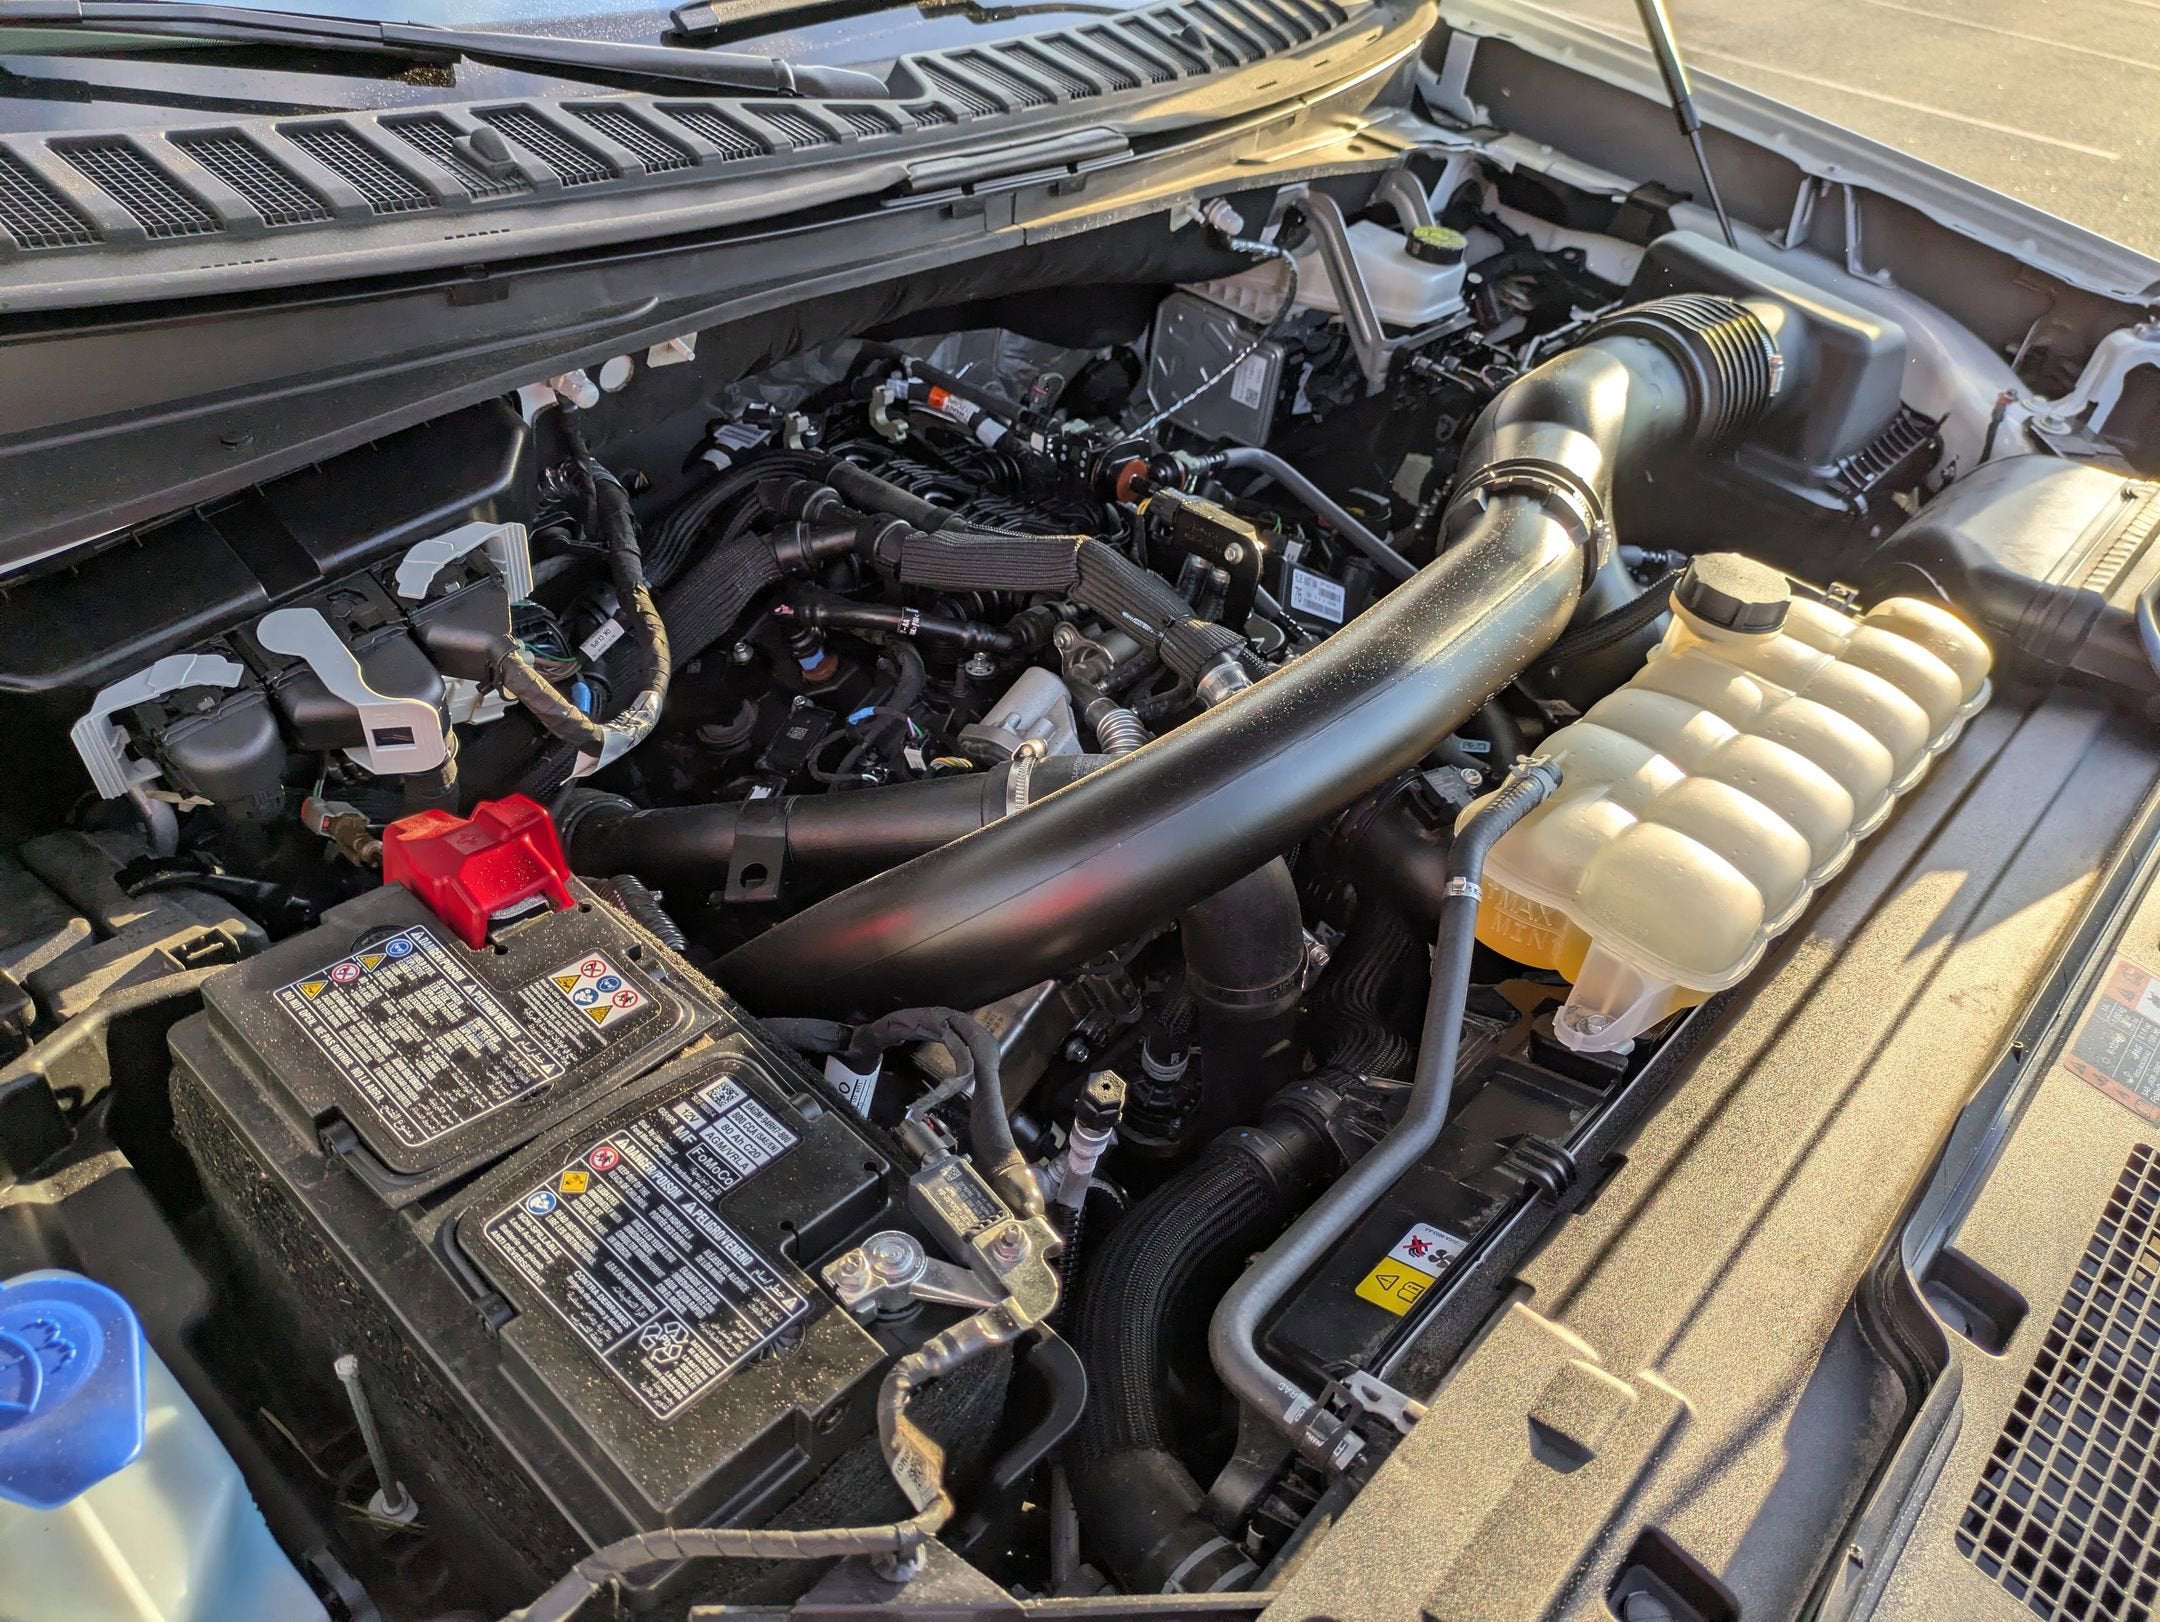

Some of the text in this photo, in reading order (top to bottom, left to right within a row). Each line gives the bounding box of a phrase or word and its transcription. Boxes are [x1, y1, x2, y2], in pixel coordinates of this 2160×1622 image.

[416, 936, 467, 982] DANGER/POISON
[469, 990, 522, 1038] PELIGRO/VENENO
[280, 990, 295, 1001] DO
[288, 998, 305, 1011] NOT
[312, 1026, 327, 1036] NE
[319, 1033, 336, 1046] PAS
[349, 1066, 364, 1078] NO
[357, 1075, 372, 1086] LA
[680, 1108, 699, 1123] 12V
[730, 1111, 747, 1124] 800
[742, 1121, 759, 1135] CCA
[742, 1102, 792, 1143] BAGM-94RH7-800
[639, 1133, 655, 1146] Motor
[670, 1124, 698, 1146] MF
[719, 1123, 762, 1159] 80 Ah C20
[704, 1131, 749, 1171] AGM/VRLA
[690, 1146, 736, 1187] FoMoCo
[638, 1186, 651, 1197] THE
[553, 1208, 569, 1223] READ
[622, 1144, 755, 1266] DANGER/POISON PELIGRO/VENENO
[516, 1211, 562, 1257] NON-SPILLABLE
[544, 1214, 560, 1228] LIRE
[554, 1224, 567, 1235] LES
[498, 1223, 545, 1271] Batterie au plomb
[508, 1216, 556, 1265] Lead Acid Battery
[489, 1229, 547, 1286] ANTI DÉVERSEMENT
[603, 1260, 617, 1272] LEA
[611, 1268, 626, 1280] LAS
[573, 1269, 600, 1296] CONTRA
[595, 1293, 632, 1328] DERRAMES
[582, 1292, 592, 1301] de
[587, 1298, 607, 1317] plomo
[606, 1317, 624, 1334] ácido
[657, 1333, 673, 1347] Pb
